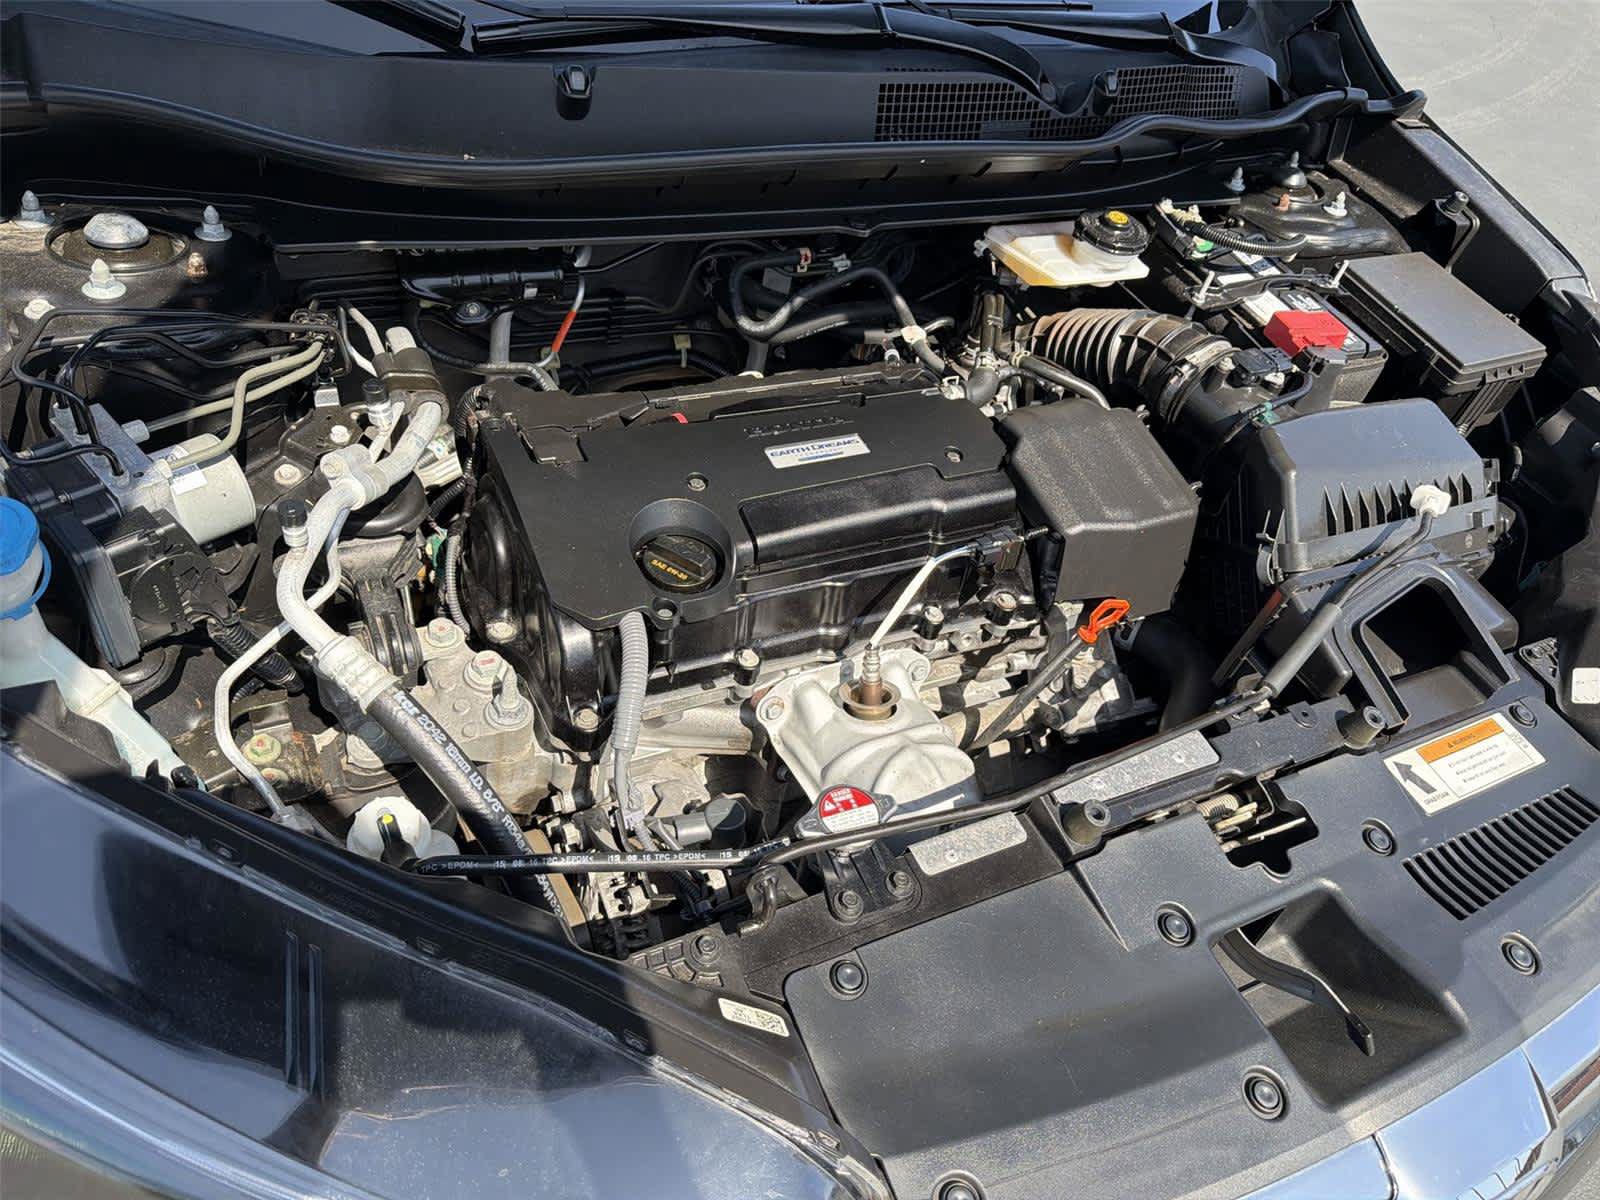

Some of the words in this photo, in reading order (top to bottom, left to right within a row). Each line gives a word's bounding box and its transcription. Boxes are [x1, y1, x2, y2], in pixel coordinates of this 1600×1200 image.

[769, 446, 810, 457] EARTH
[811, 439, 860, 451] DREAMS
[416, 713, 448, 745] 2042
